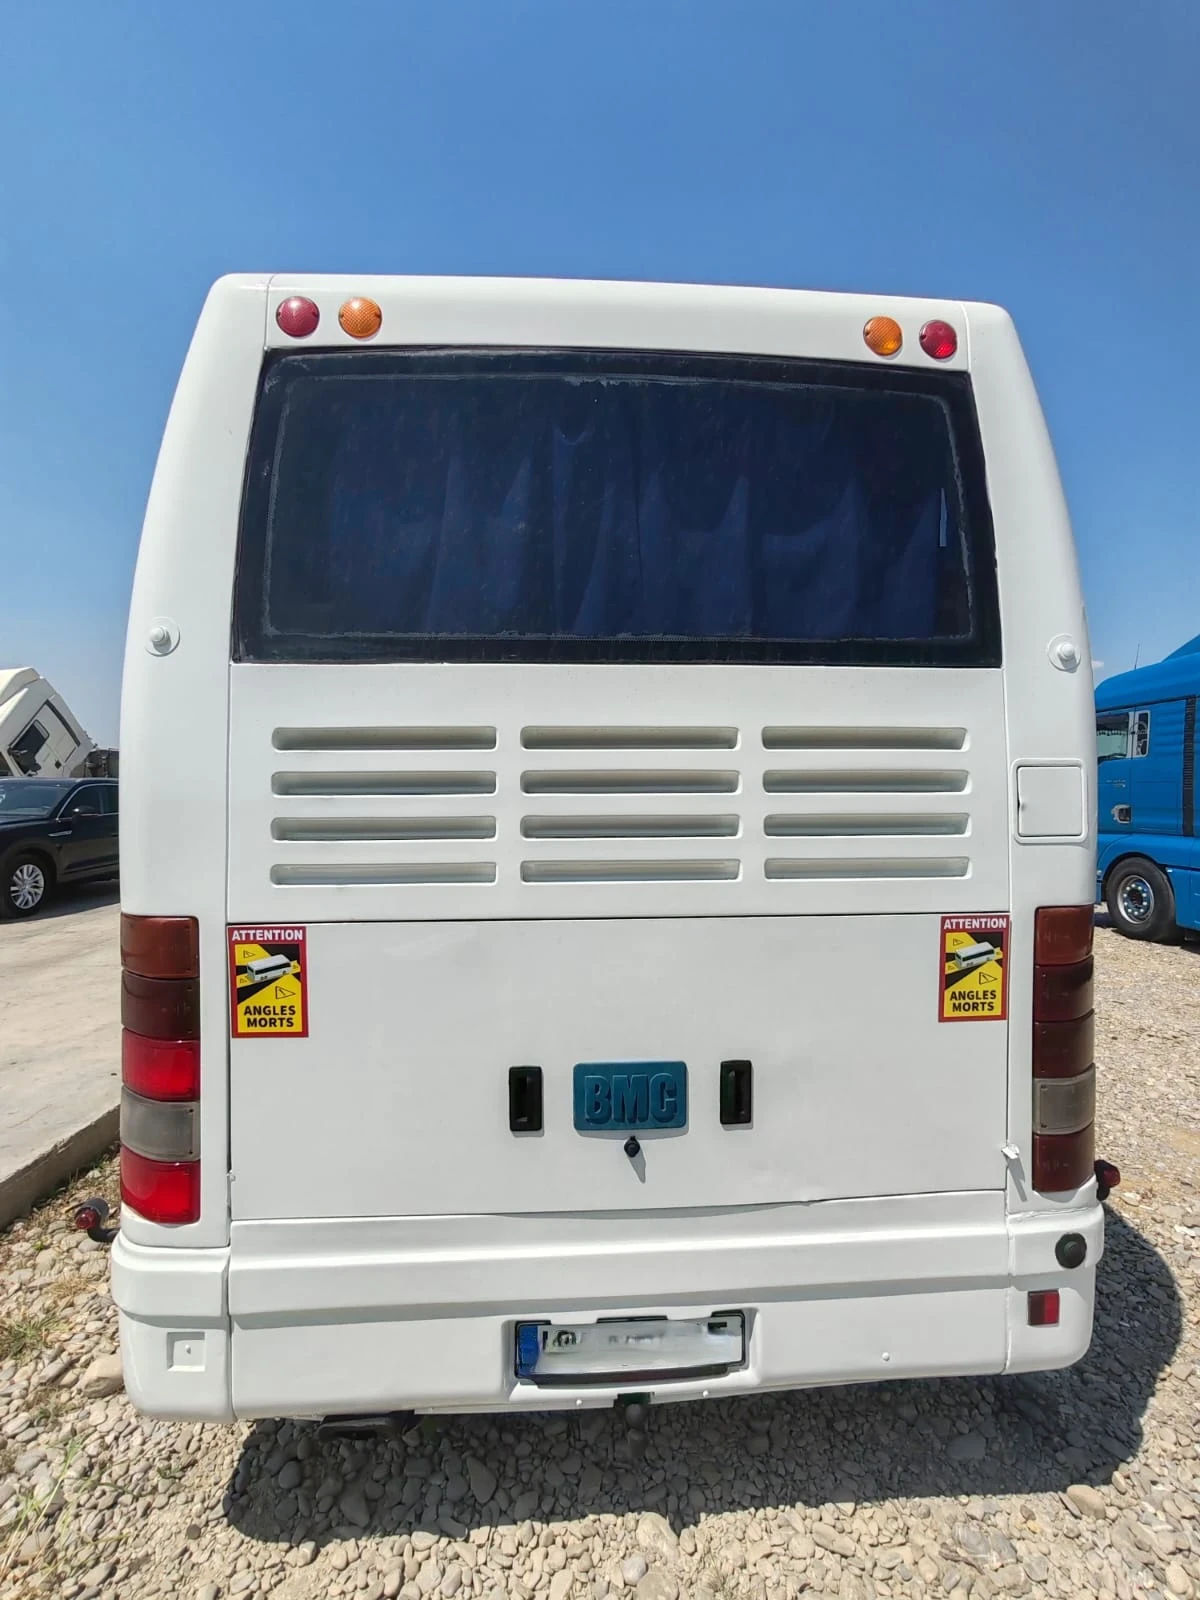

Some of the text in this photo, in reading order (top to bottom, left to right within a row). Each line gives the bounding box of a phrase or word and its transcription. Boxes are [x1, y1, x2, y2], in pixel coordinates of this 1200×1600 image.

[944, 918, 1006, 929] ATTENTION
[232, 929, 302, 940] ATTENTION
[950, 990, 996, 1001] ANGLES
[244, 1005, 296, 1016] ANGLES
[952, 1002, 994, 1012] MORTS
[247, 1017, 294, 1028] MORTS
[584, 1073, 677, 1124] BMC
